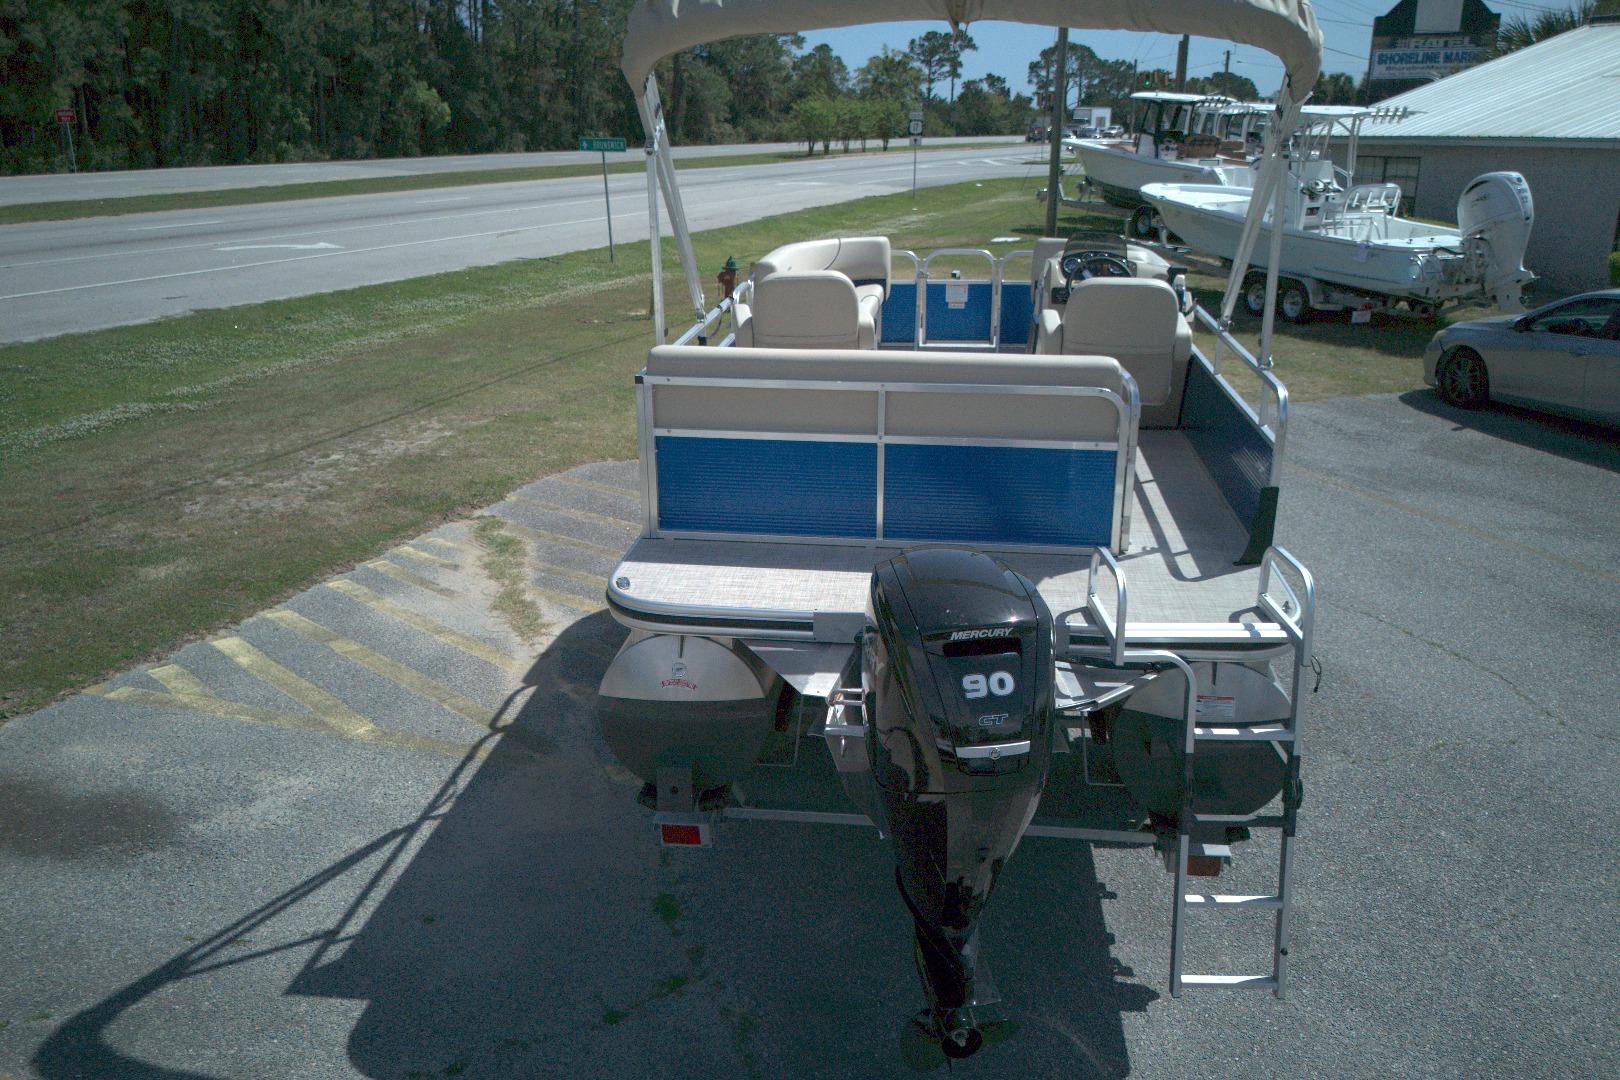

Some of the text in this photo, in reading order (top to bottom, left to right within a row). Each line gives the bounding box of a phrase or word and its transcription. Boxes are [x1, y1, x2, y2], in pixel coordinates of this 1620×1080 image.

[1377, 52, 1441, 65] SHORELINE
[950, 627, 1013, 640] MERCURY
[962, 670, 1015, 699] 90
[979, 713, 1009, 726] GT
